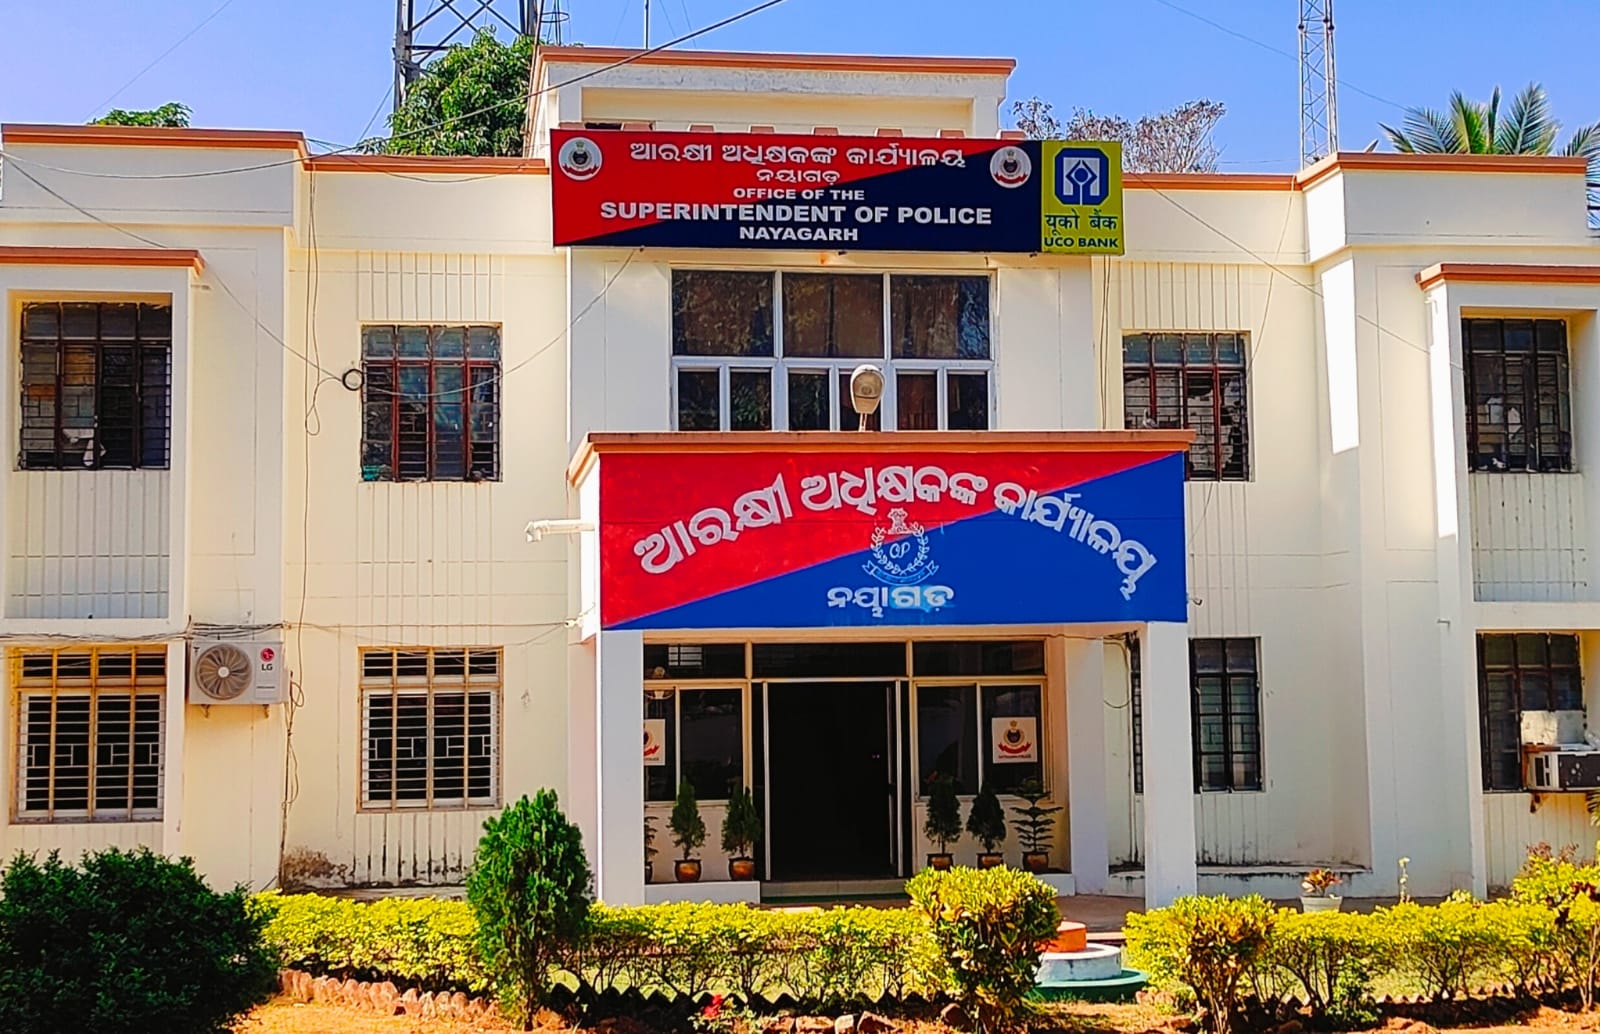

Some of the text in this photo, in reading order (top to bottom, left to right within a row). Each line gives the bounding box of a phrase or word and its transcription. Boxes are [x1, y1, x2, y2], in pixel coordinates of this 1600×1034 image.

[733, 187, 865, 201] OFFICE OF THE
[600, 201, 992, 225] SUPERINTENDENT OF POLICE
[1044, 208, 1081, 236] यूको
[739, 226, 858, 242] NAYAGARH
[1043, 236, 1119, 249] UCO BANK
[261, 663, 273, 671] LG
